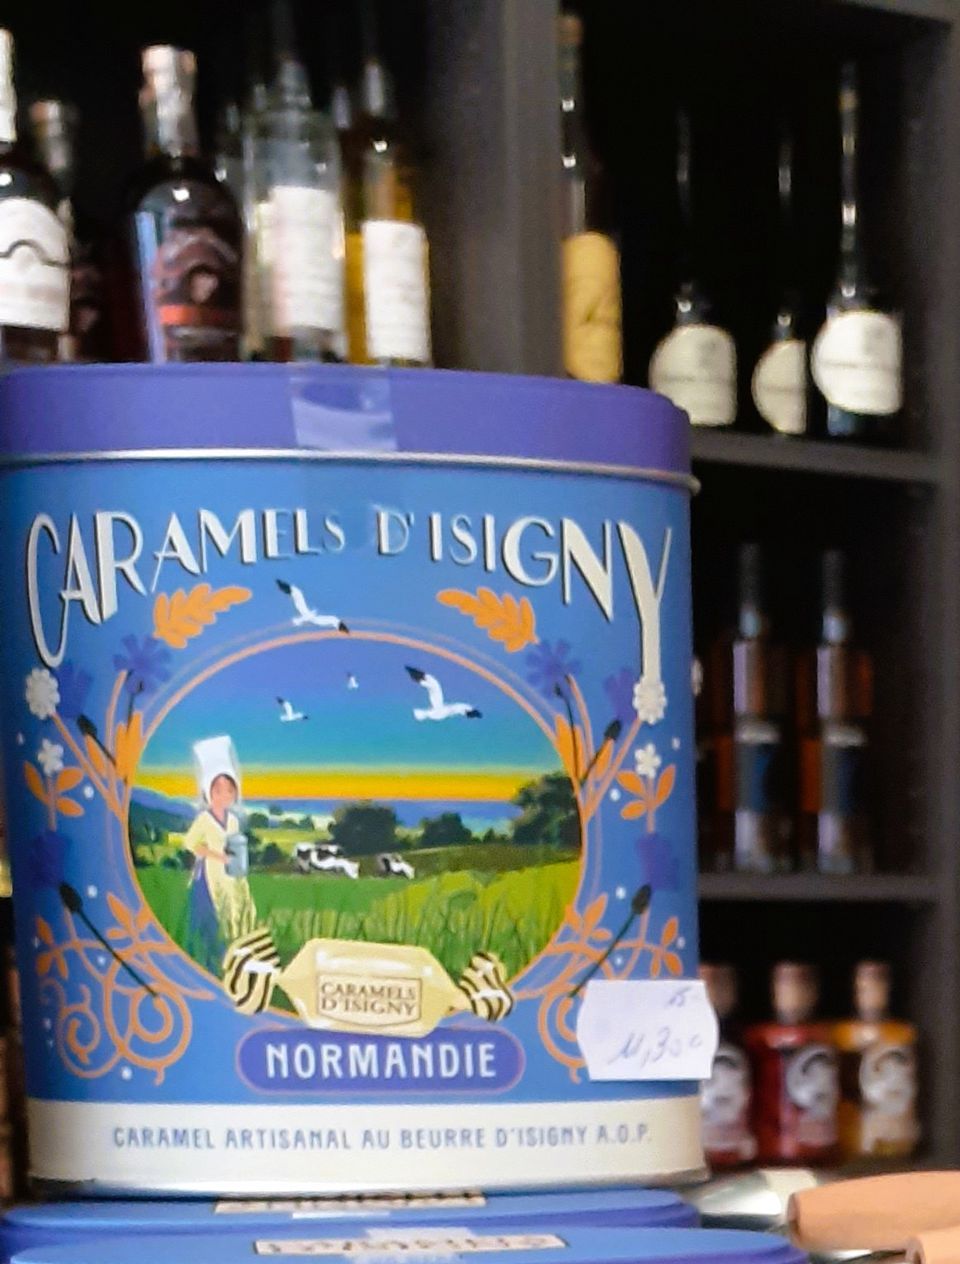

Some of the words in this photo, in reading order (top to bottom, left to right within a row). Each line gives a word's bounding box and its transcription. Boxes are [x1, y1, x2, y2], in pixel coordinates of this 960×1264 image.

[26, 510, 346, 667] CARAMELS
[377, 510, 672, 684] D'ISIGNY
[320, 980, 416, 1000] CARAMELS
[320, 998, 417, 1017] D'ISIGNY
[265, 1042, 497, 1080] NORMANDIE
[113, 1127, 215, 1149] CARAMEL
[225, 1127, 352, 1150] ARTISANAL
[362, 1127, 391, 1149] AU
[400, 1127, 486, 1149] BEURRE
[496, 1125, 588, 1148] D'ISIGNY
